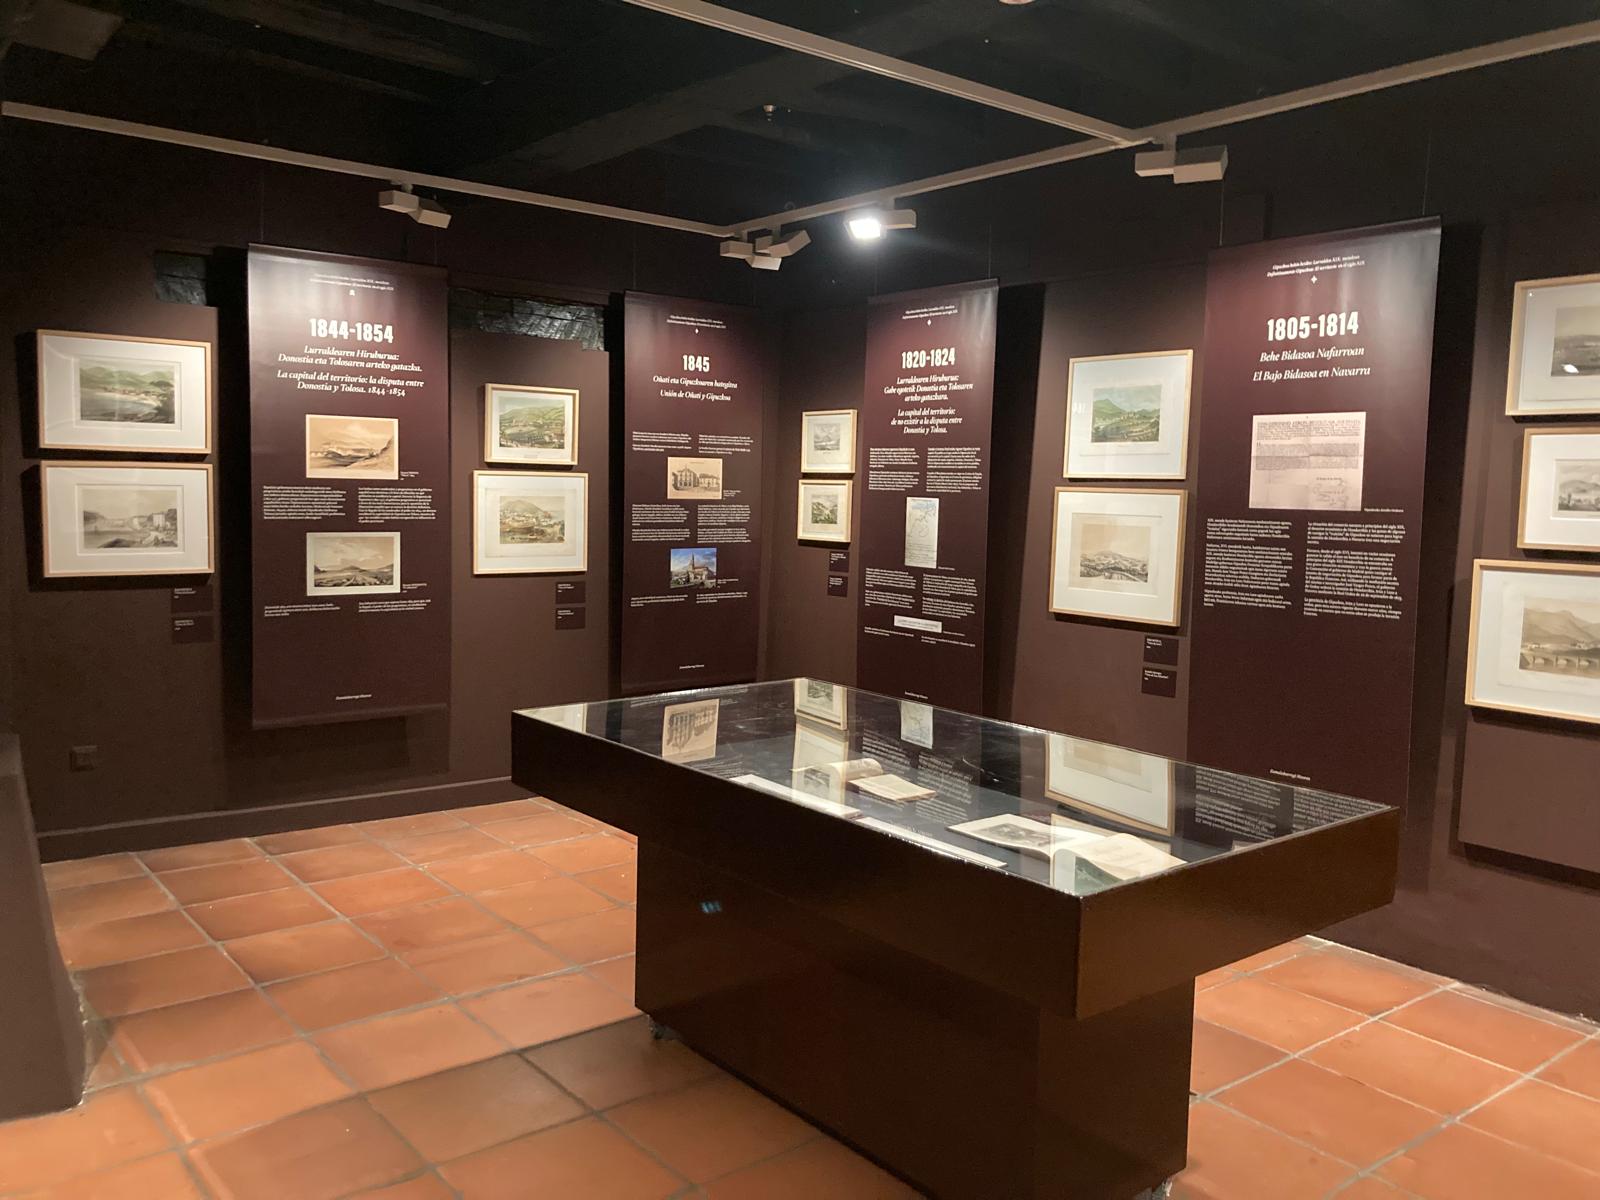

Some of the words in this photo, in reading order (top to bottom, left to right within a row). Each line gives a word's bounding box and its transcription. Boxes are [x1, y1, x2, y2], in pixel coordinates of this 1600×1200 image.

[309, 318, 393, 343] 1844-1854
[1267, 311, 1359, 341] 1805-1814
[304, 345, 356, 356] Lurraldearen
[356, 350, 399, 360] Hiruburua:
[902, 347, 955, 369] 1820-1824
[1260, 351, 1280, 362] Behe
[1281, 349, 1315, 361] Bidasoa
[1316, 346, 1365, 360] Nafarroan
[278, 353, 314, 364] Donostia
[315, 357, 328, 365] eta
[329, 357, 365, 368] Tolosaren
[366, 361, 390, 370] arteko
[391, 363, 422, 372] gatazka.
[682, 354, 710, 373] 1845
[277, 370, 288, 378] La
[288, 371, 316, 381] capital
[317, 372, 330, 380] del
[330, 373, 369, 384] territorio:
[369, 376, 377, 384] la
[377, 377, 404, 387] disputa
[405, 380, 424, 388] entre
[1253, 370, 1262, 381] El
[1263, 370, 1282, 383] Bajo
[1283, 368, 1317, 380] Bidasoa
[1318, 369, 1330, 378] en
[1331, 366, 1371, 377] Navarra
[297, 381, 332, 391] Donostia
[334, 385, 338, 393] y
[341, 384, 366, 393] Tolosa.
[916, 384, 939, 393] Donostia
[701, 393, 706, 401] y
[890, 417, 897, 425] de
[923, 416, 929, 425] la
[905, 408, 922, 418] capital
[922, 407, 930, 416] del
[903, 426, 925, 434] Donostia
